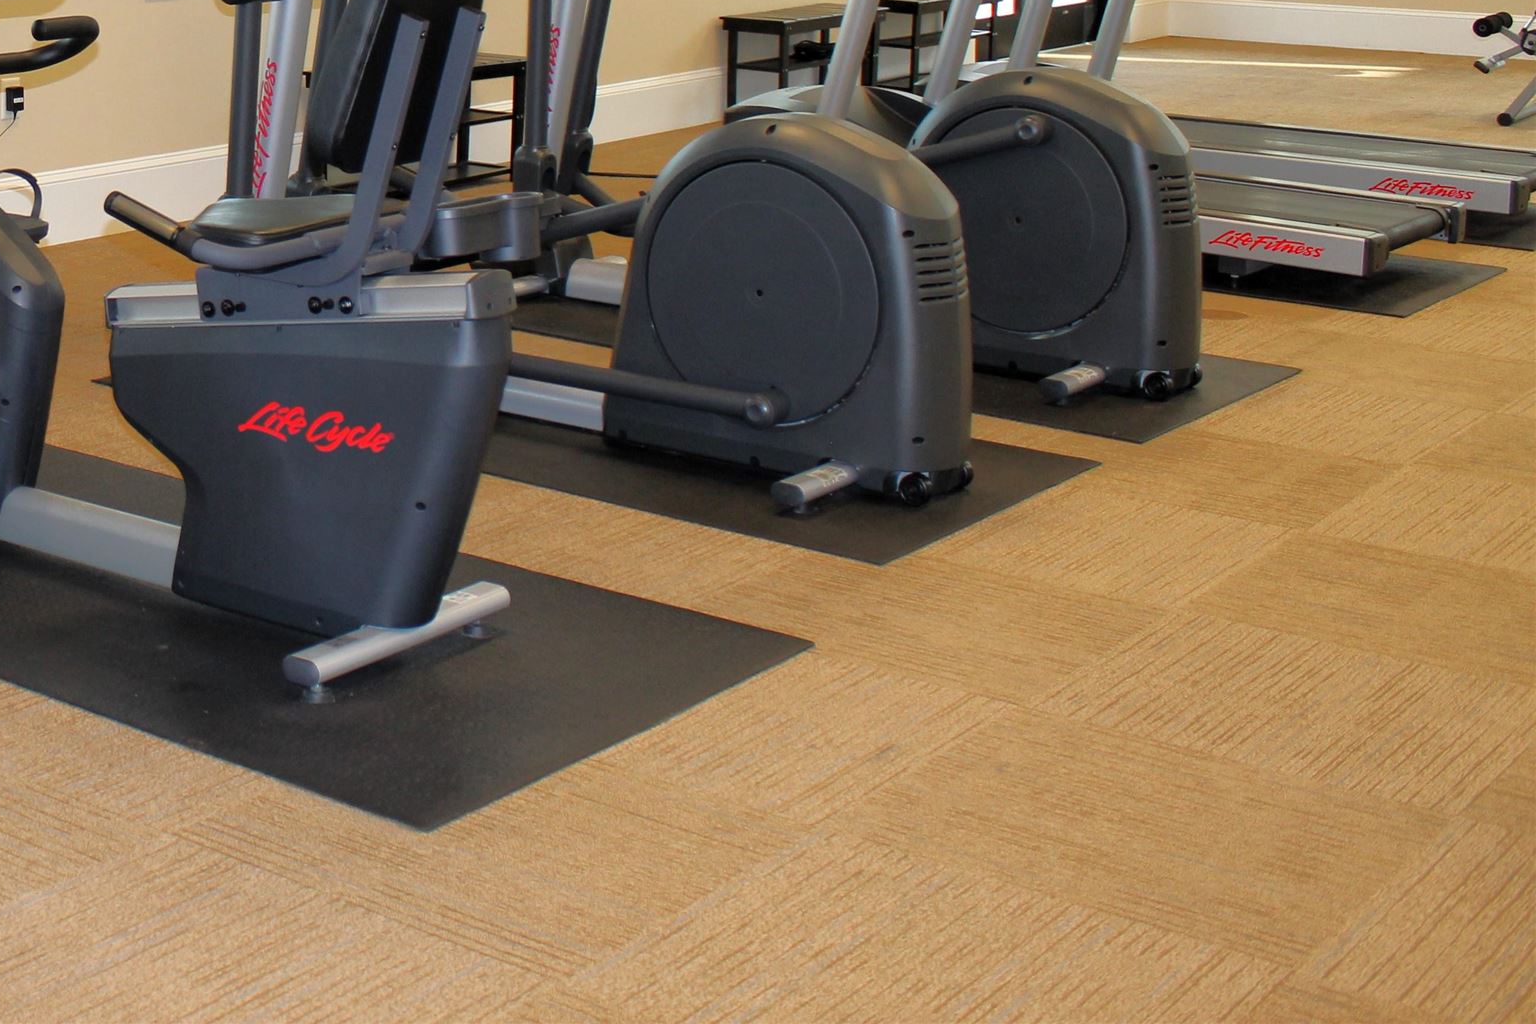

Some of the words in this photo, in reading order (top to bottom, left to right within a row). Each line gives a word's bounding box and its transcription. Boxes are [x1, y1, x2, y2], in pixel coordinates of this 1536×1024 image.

[1368, 177, 1410, 195] Life
[1406, 181, 1476, 201] Fitness
[1209, 230, 1253, 249] Life
[1249, 235, 1325, 259] Fitness
[238, 401, 307, 442] Life
[306, 410, 395, 453] Cycle
